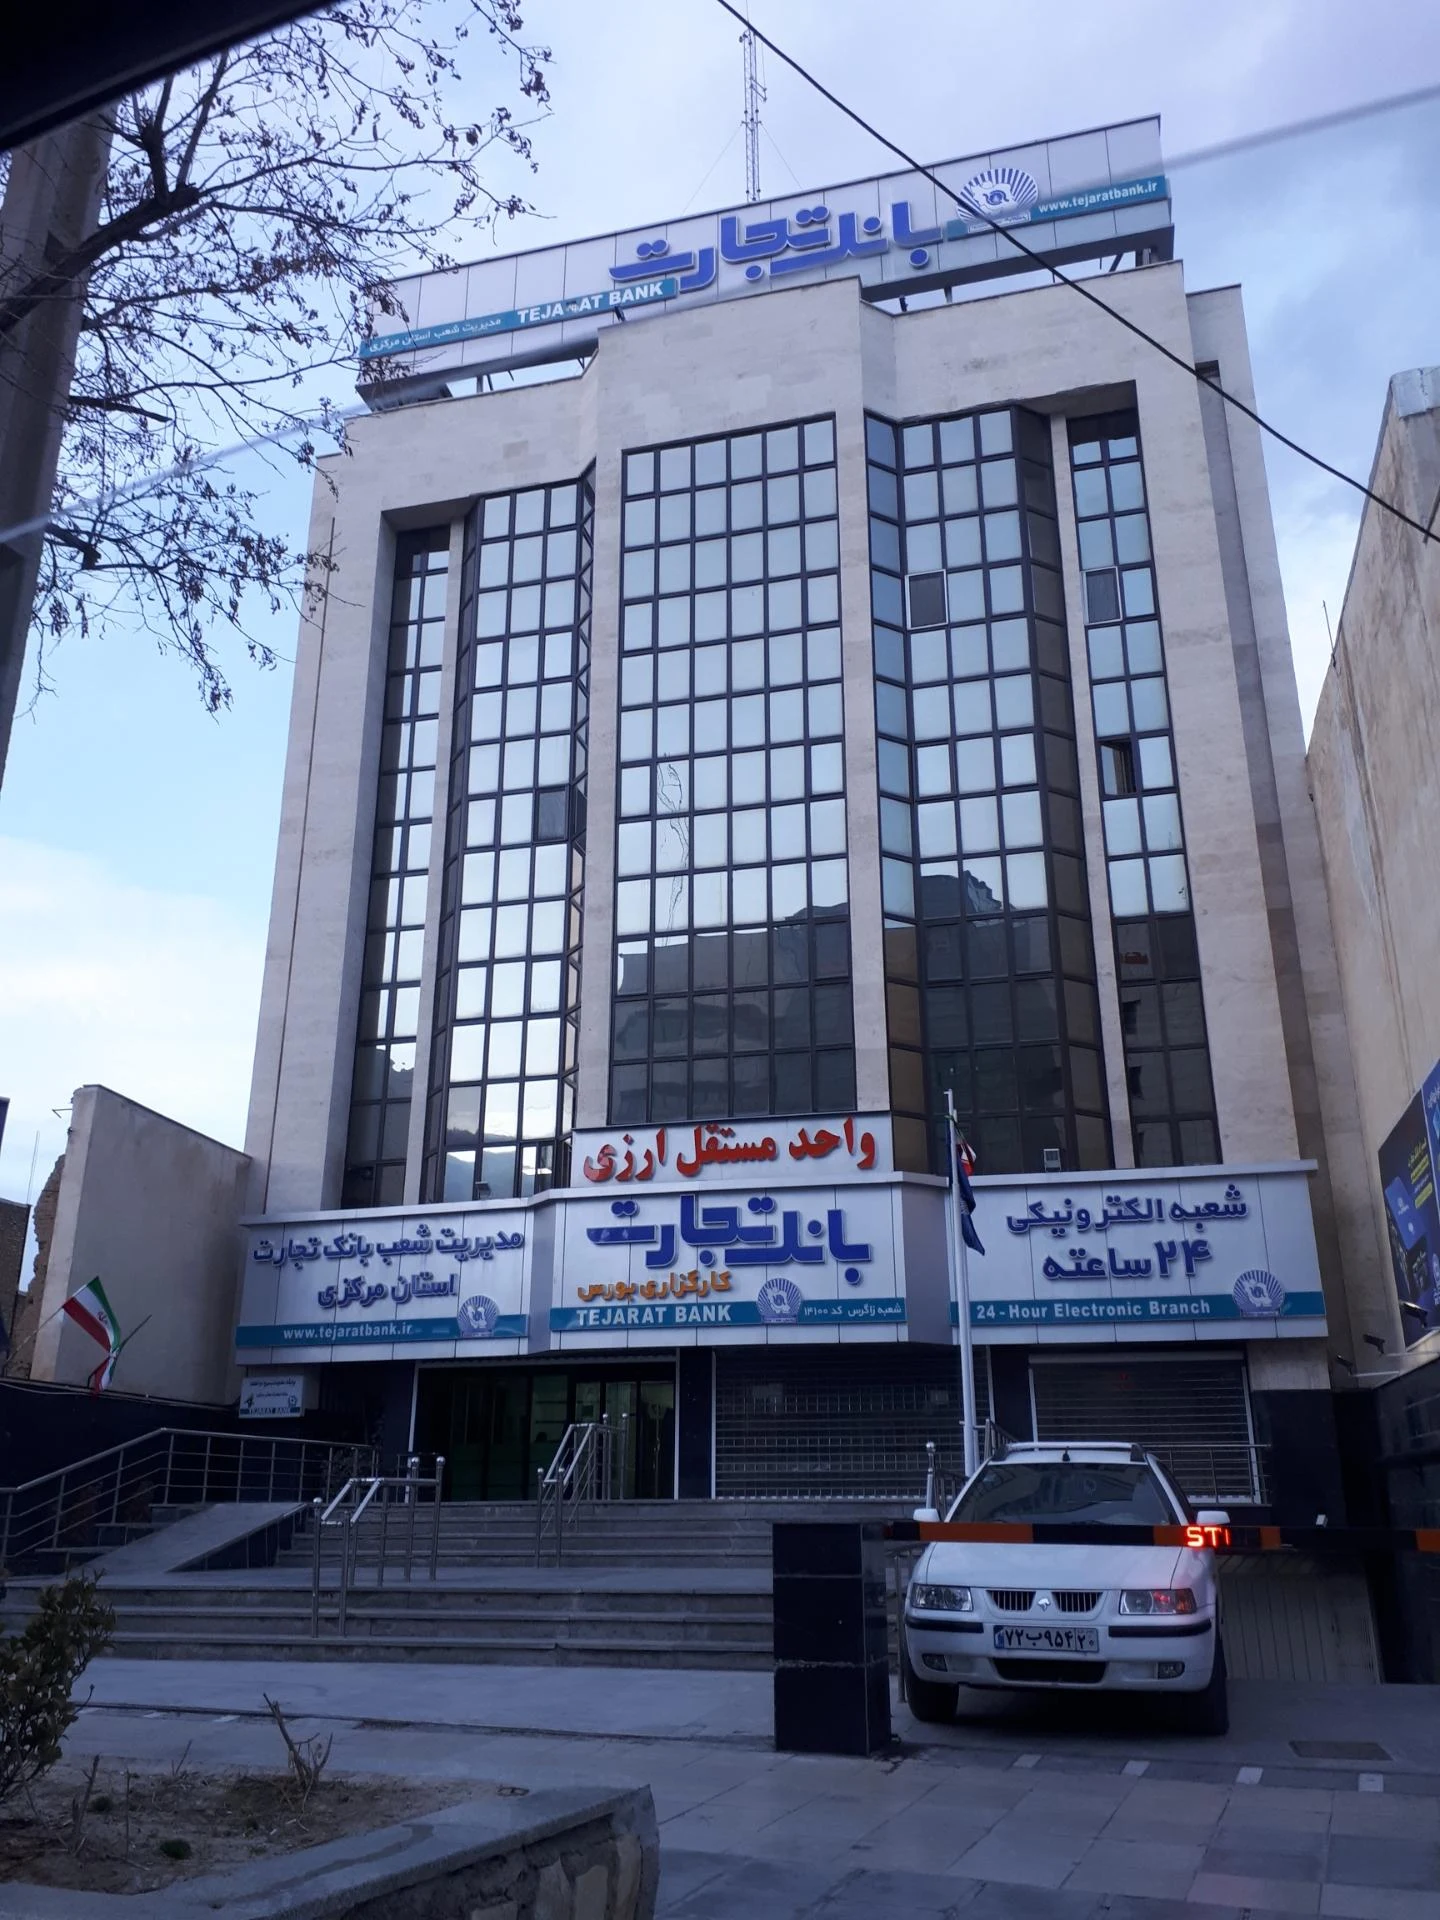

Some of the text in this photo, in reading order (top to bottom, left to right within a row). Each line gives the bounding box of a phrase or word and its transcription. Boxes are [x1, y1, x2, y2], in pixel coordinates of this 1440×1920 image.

[1038, 181, 1158, 213] www.tejaratbank.ir
[608, 200, 944, 294] بانک تجارت
[517, 281, 664, 324] TEJAAT BANK
[369, 317, 502, 353] مدیریت شعب استان مرکزی
[583, 1116, 877, 1182] واحد مستقل ارزی
[1006, 1184, 1248, 1237] شعبه الکترونیکی
[253, 1224, 525, 1270] مدیریت شعب بانک تجارت
[586, 1193, 871, 1285] بانک تجارت
[1042, 1239, 1213, 1280] ۲۴ ساعته
[317, 1271, 458, 1310] استان مرکزی
[577, 1269, 732, 1302] کارگزاری بورس
[576, 1304, 731, 1327] TEJARAT BANK
[831, 1305, 843, 1315] کد
[847, 1303, 876, 1317] زاگرس
[877, 1302, 902, 1317] شعبه
[1054, 1302, 1143, 1318] Electronic
[1149, 1299, 1211, 1316] Branch
[283, 1321, 413, 1341] www.tejaratbank.ir
